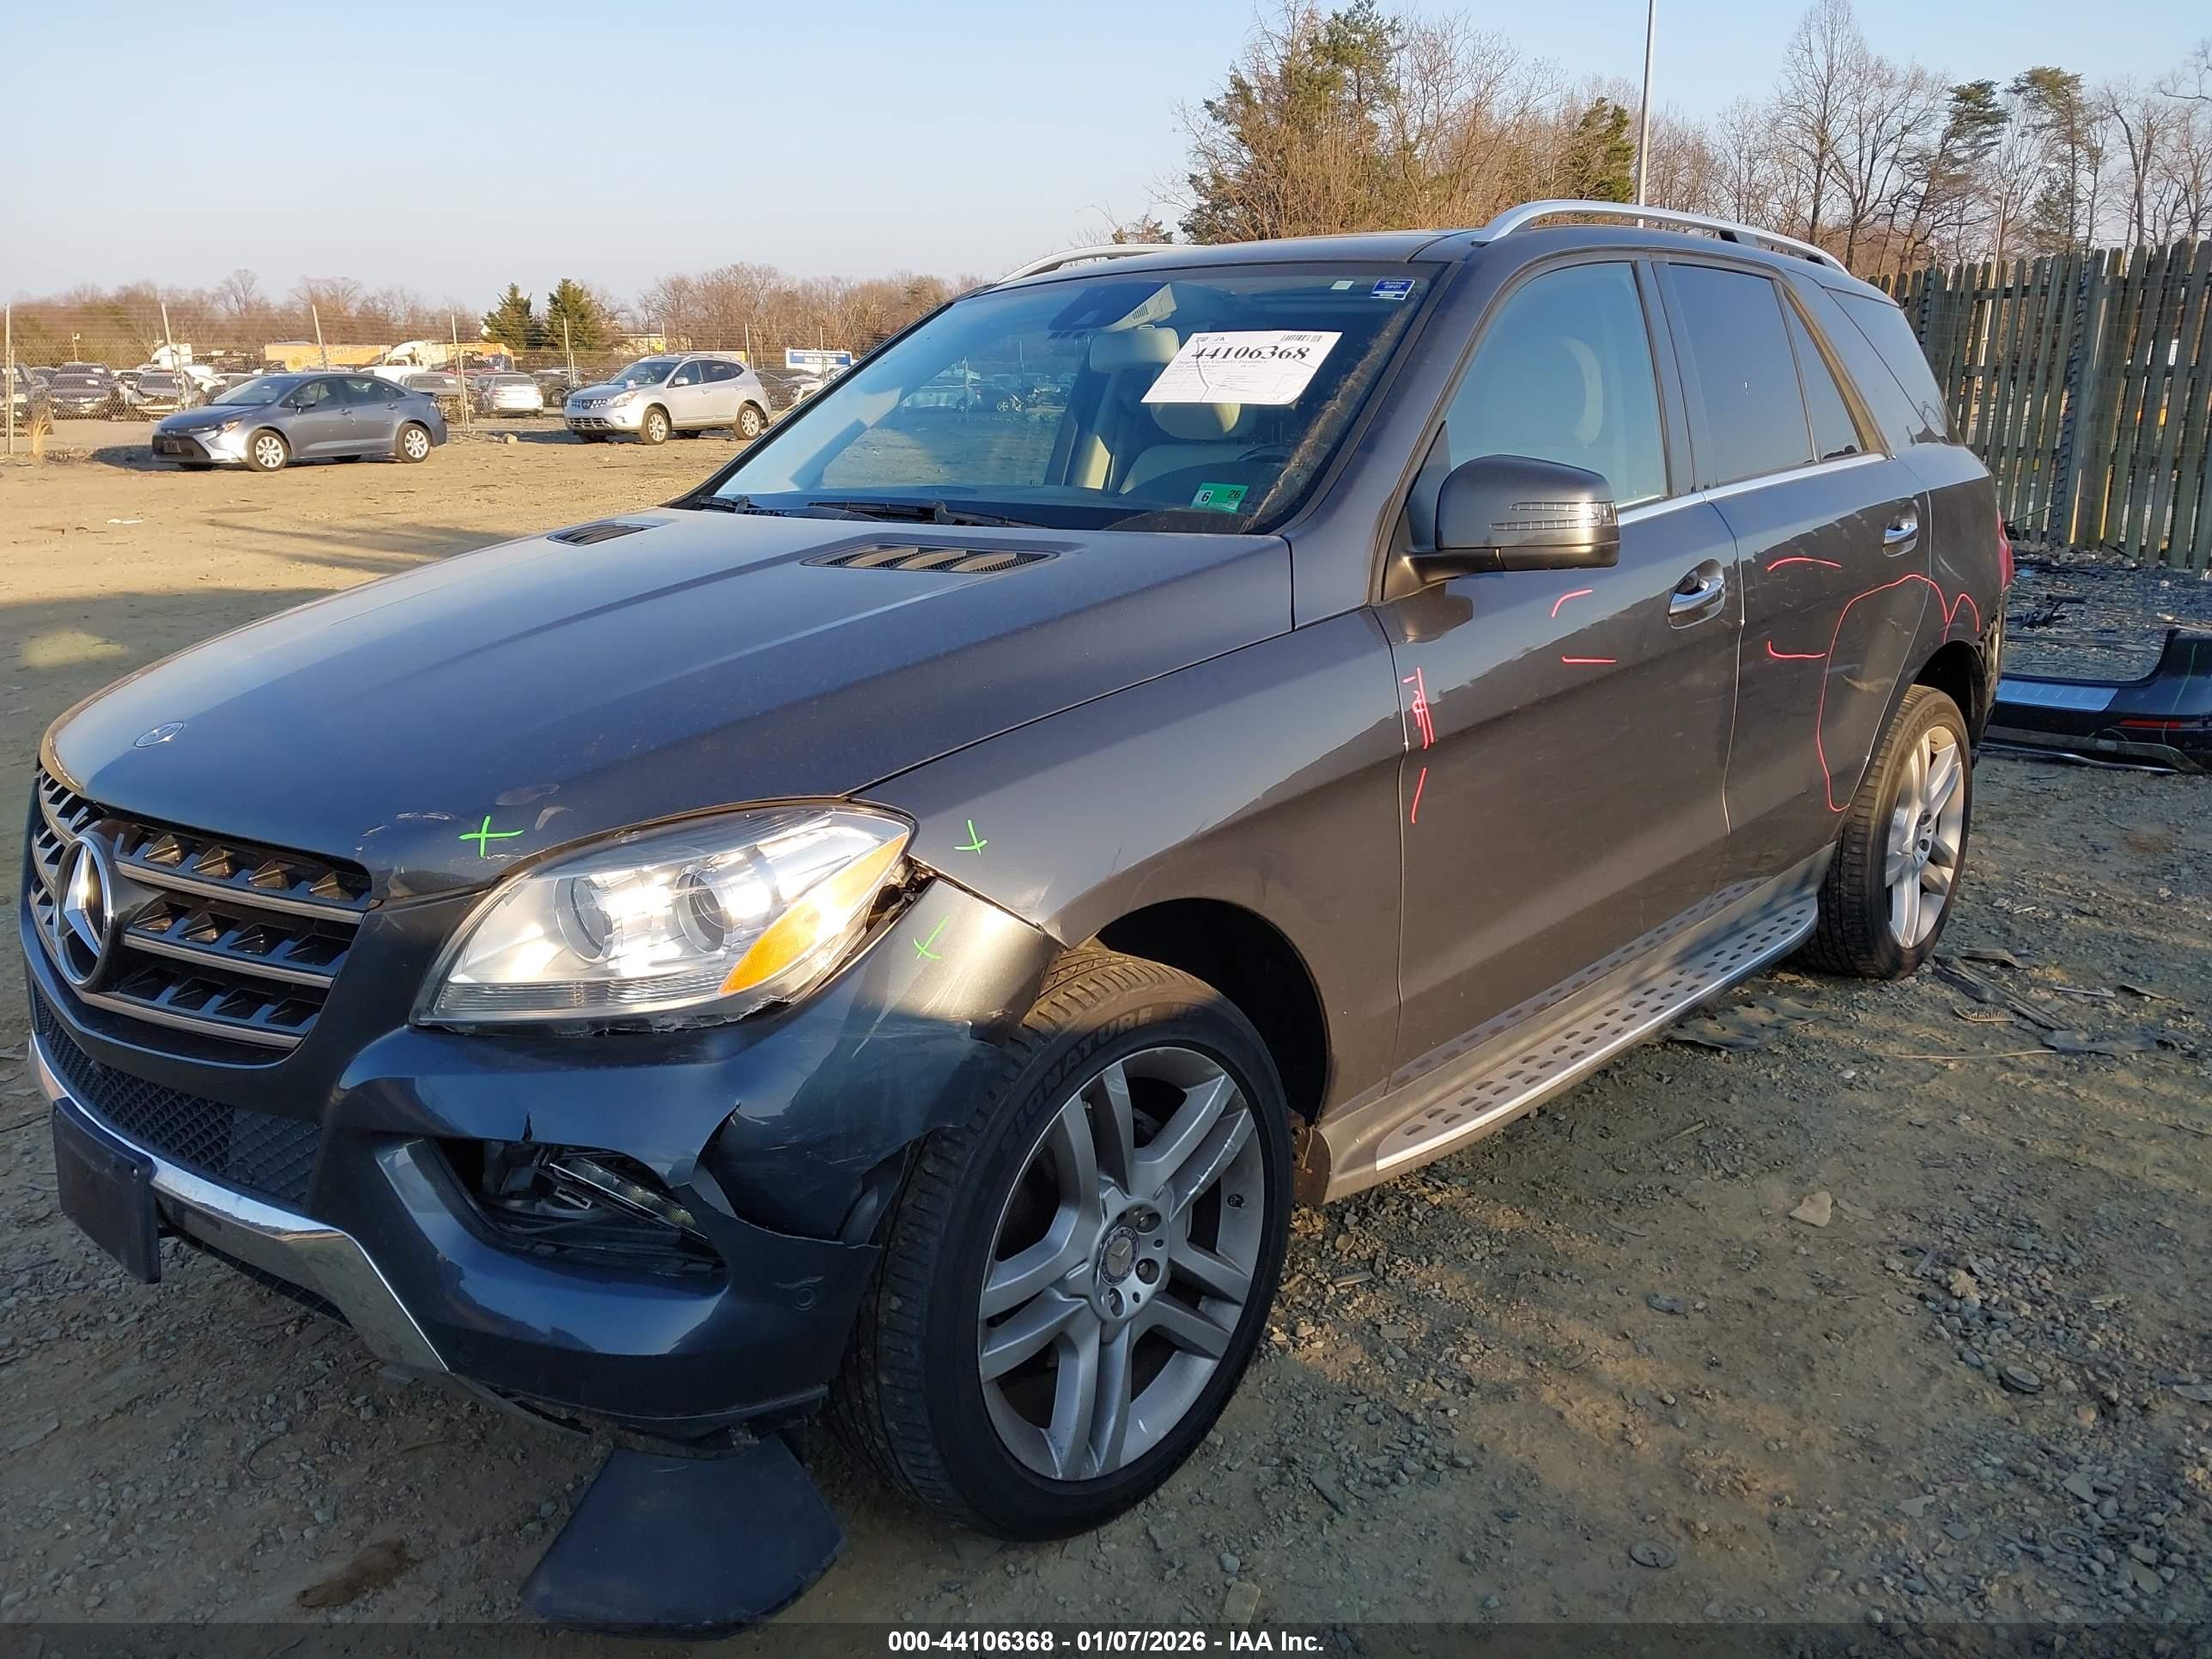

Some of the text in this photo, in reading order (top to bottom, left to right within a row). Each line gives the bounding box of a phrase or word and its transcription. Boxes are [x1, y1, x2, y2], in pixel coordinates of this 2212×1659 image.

[1190, 345, 1311, 360] 44106368
[1200, 489, 1243, 502] 6 26
[999, 1006, 1153, 1152] SIGNATURE
